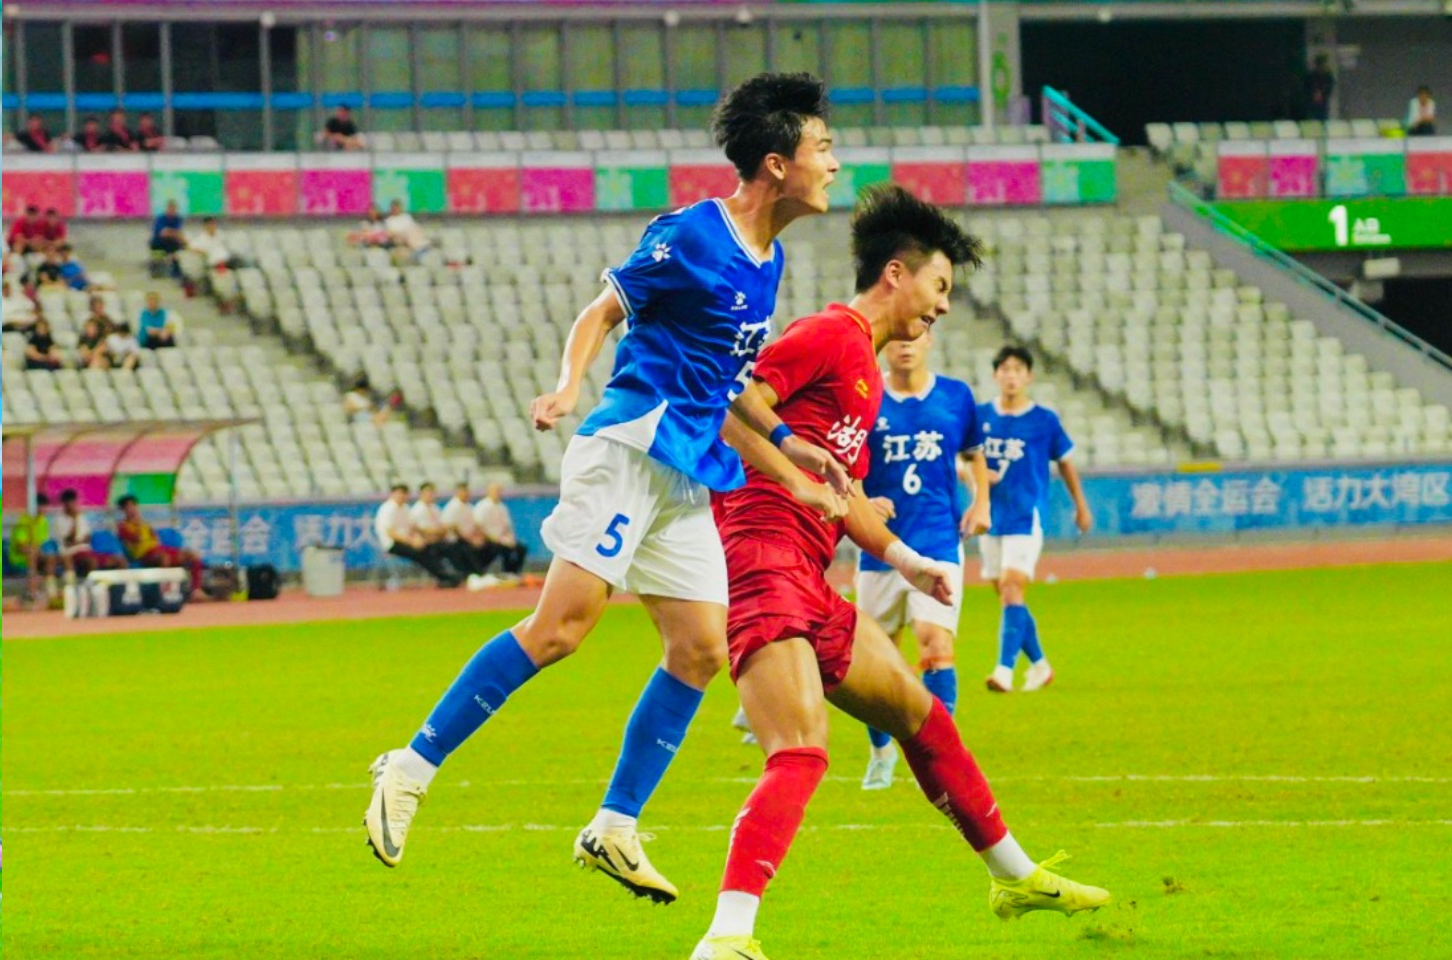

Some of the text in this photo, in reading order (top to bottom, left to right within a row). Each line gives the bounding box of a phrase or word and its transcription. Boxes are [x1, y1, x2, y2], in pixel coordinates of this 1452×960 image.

[1328, 204, 1348, 247] 1
[882, 430, 944, 464] 江苏
[984, 436, 1026, 461] 江苏
[902, 463, 922, 495] 6
[595, 513, 630, 558] 5
